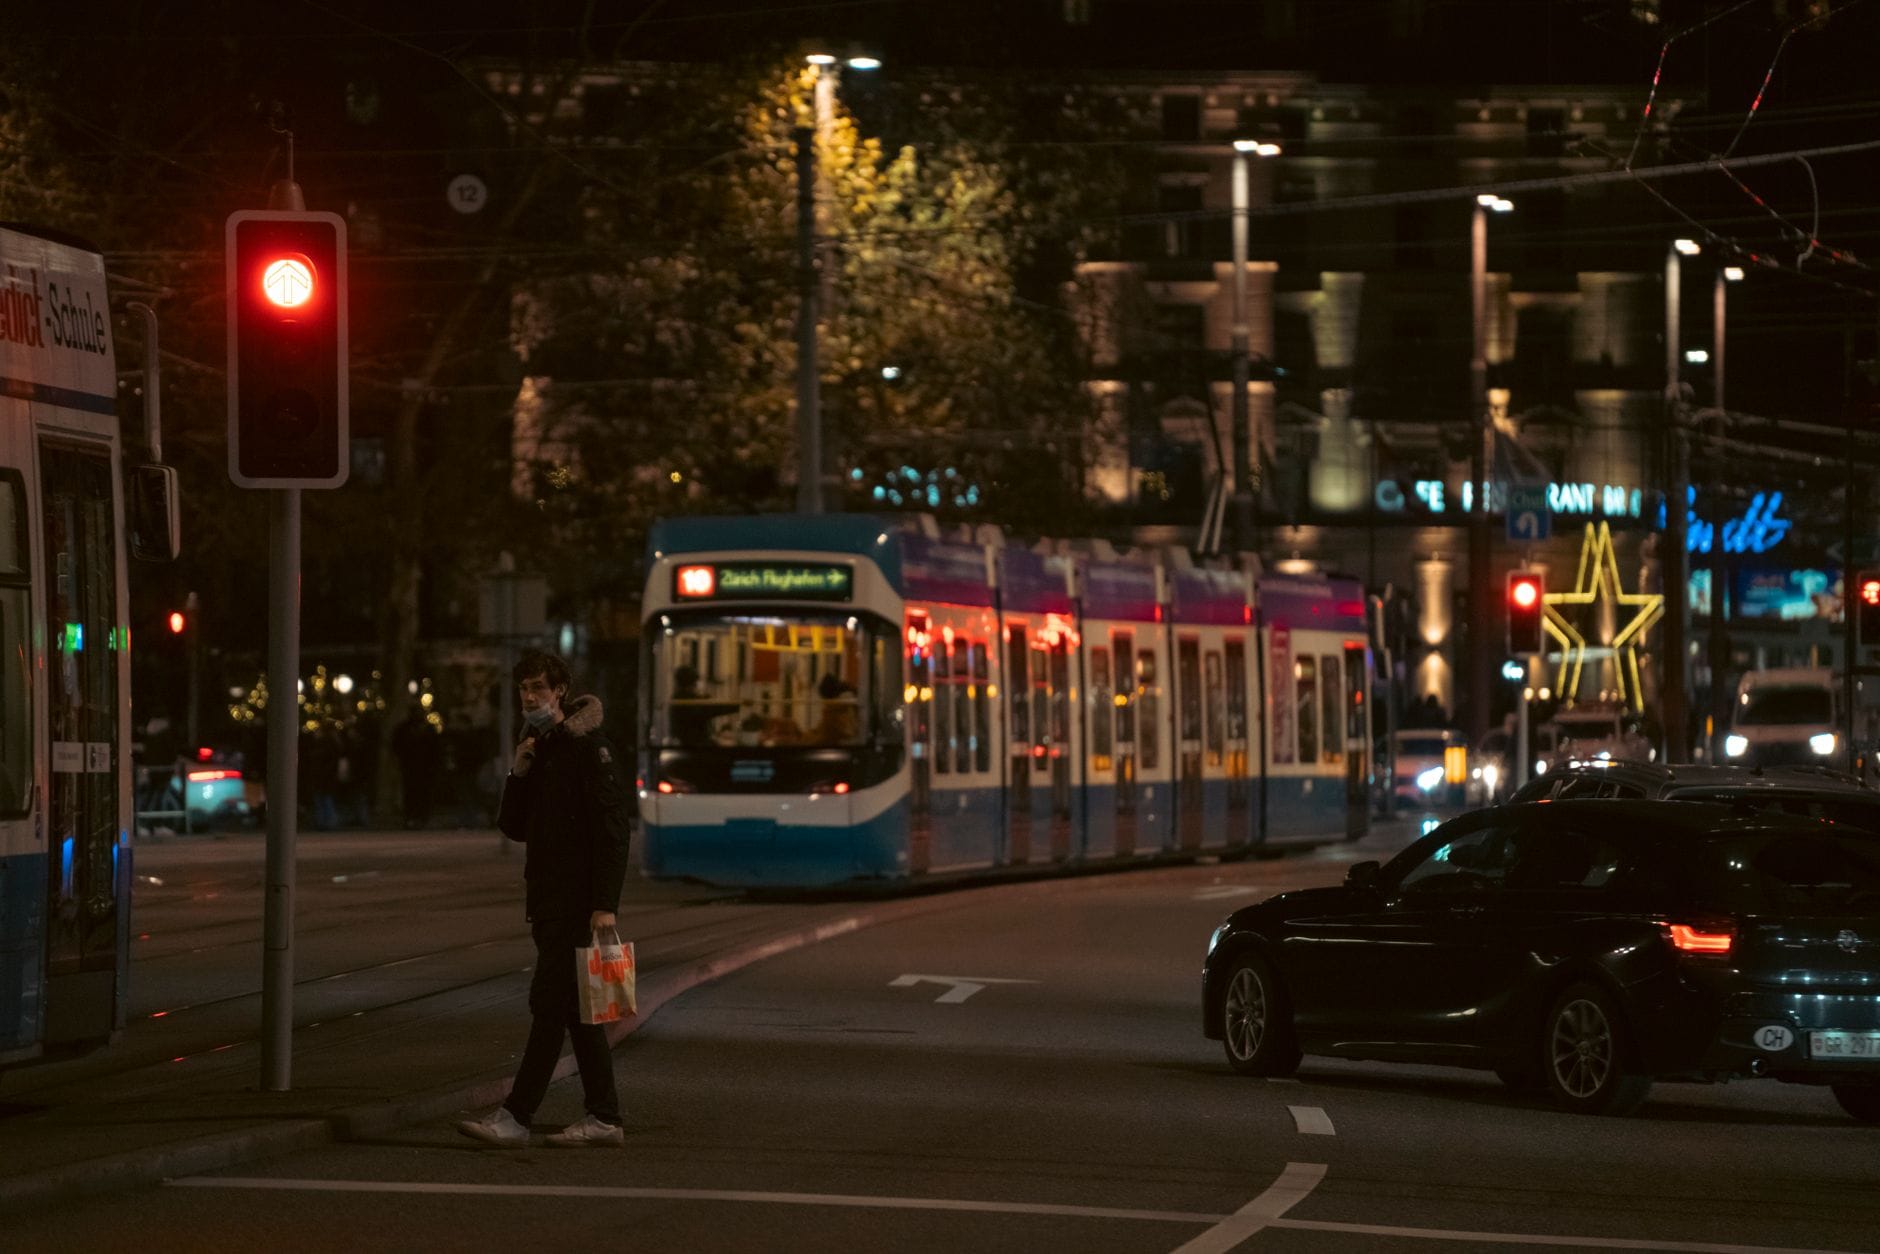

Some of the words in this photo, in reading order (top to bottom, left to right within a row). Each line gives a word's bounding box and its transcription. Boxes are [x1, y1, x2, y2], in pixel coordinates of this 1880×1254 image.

[457, 184, 478, 203] 12
[763, 568, 824, 591] Flughafen
[1762, 1029, 1784, 1047] CH
